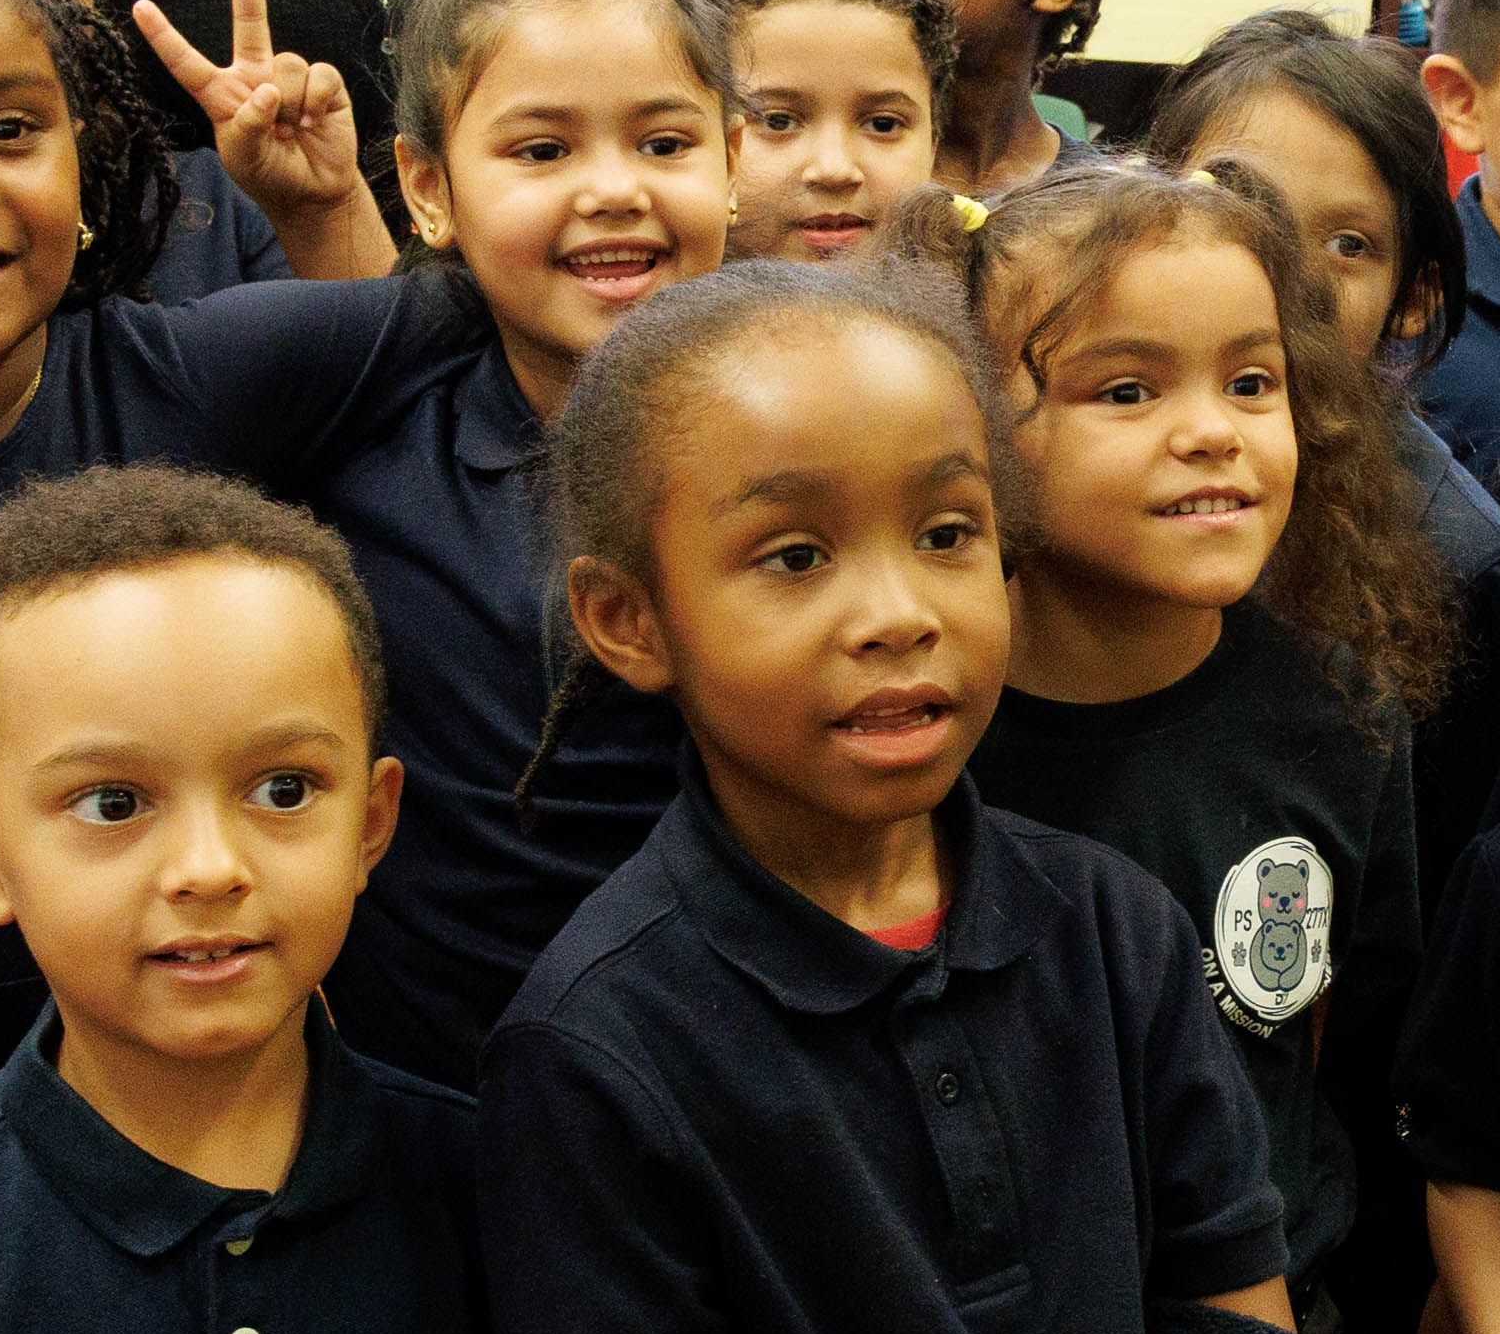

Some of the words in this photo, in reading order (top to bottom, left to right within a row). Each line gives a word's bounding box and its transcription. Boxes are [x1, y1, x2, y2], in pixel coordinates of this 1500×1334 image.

[1235, 910, 1253, 932] PS
[1200, 947, 1220, 979] ON
[1209, 981, 1226, 998] A
[1218, 994, 1274, 1040] MISSION
